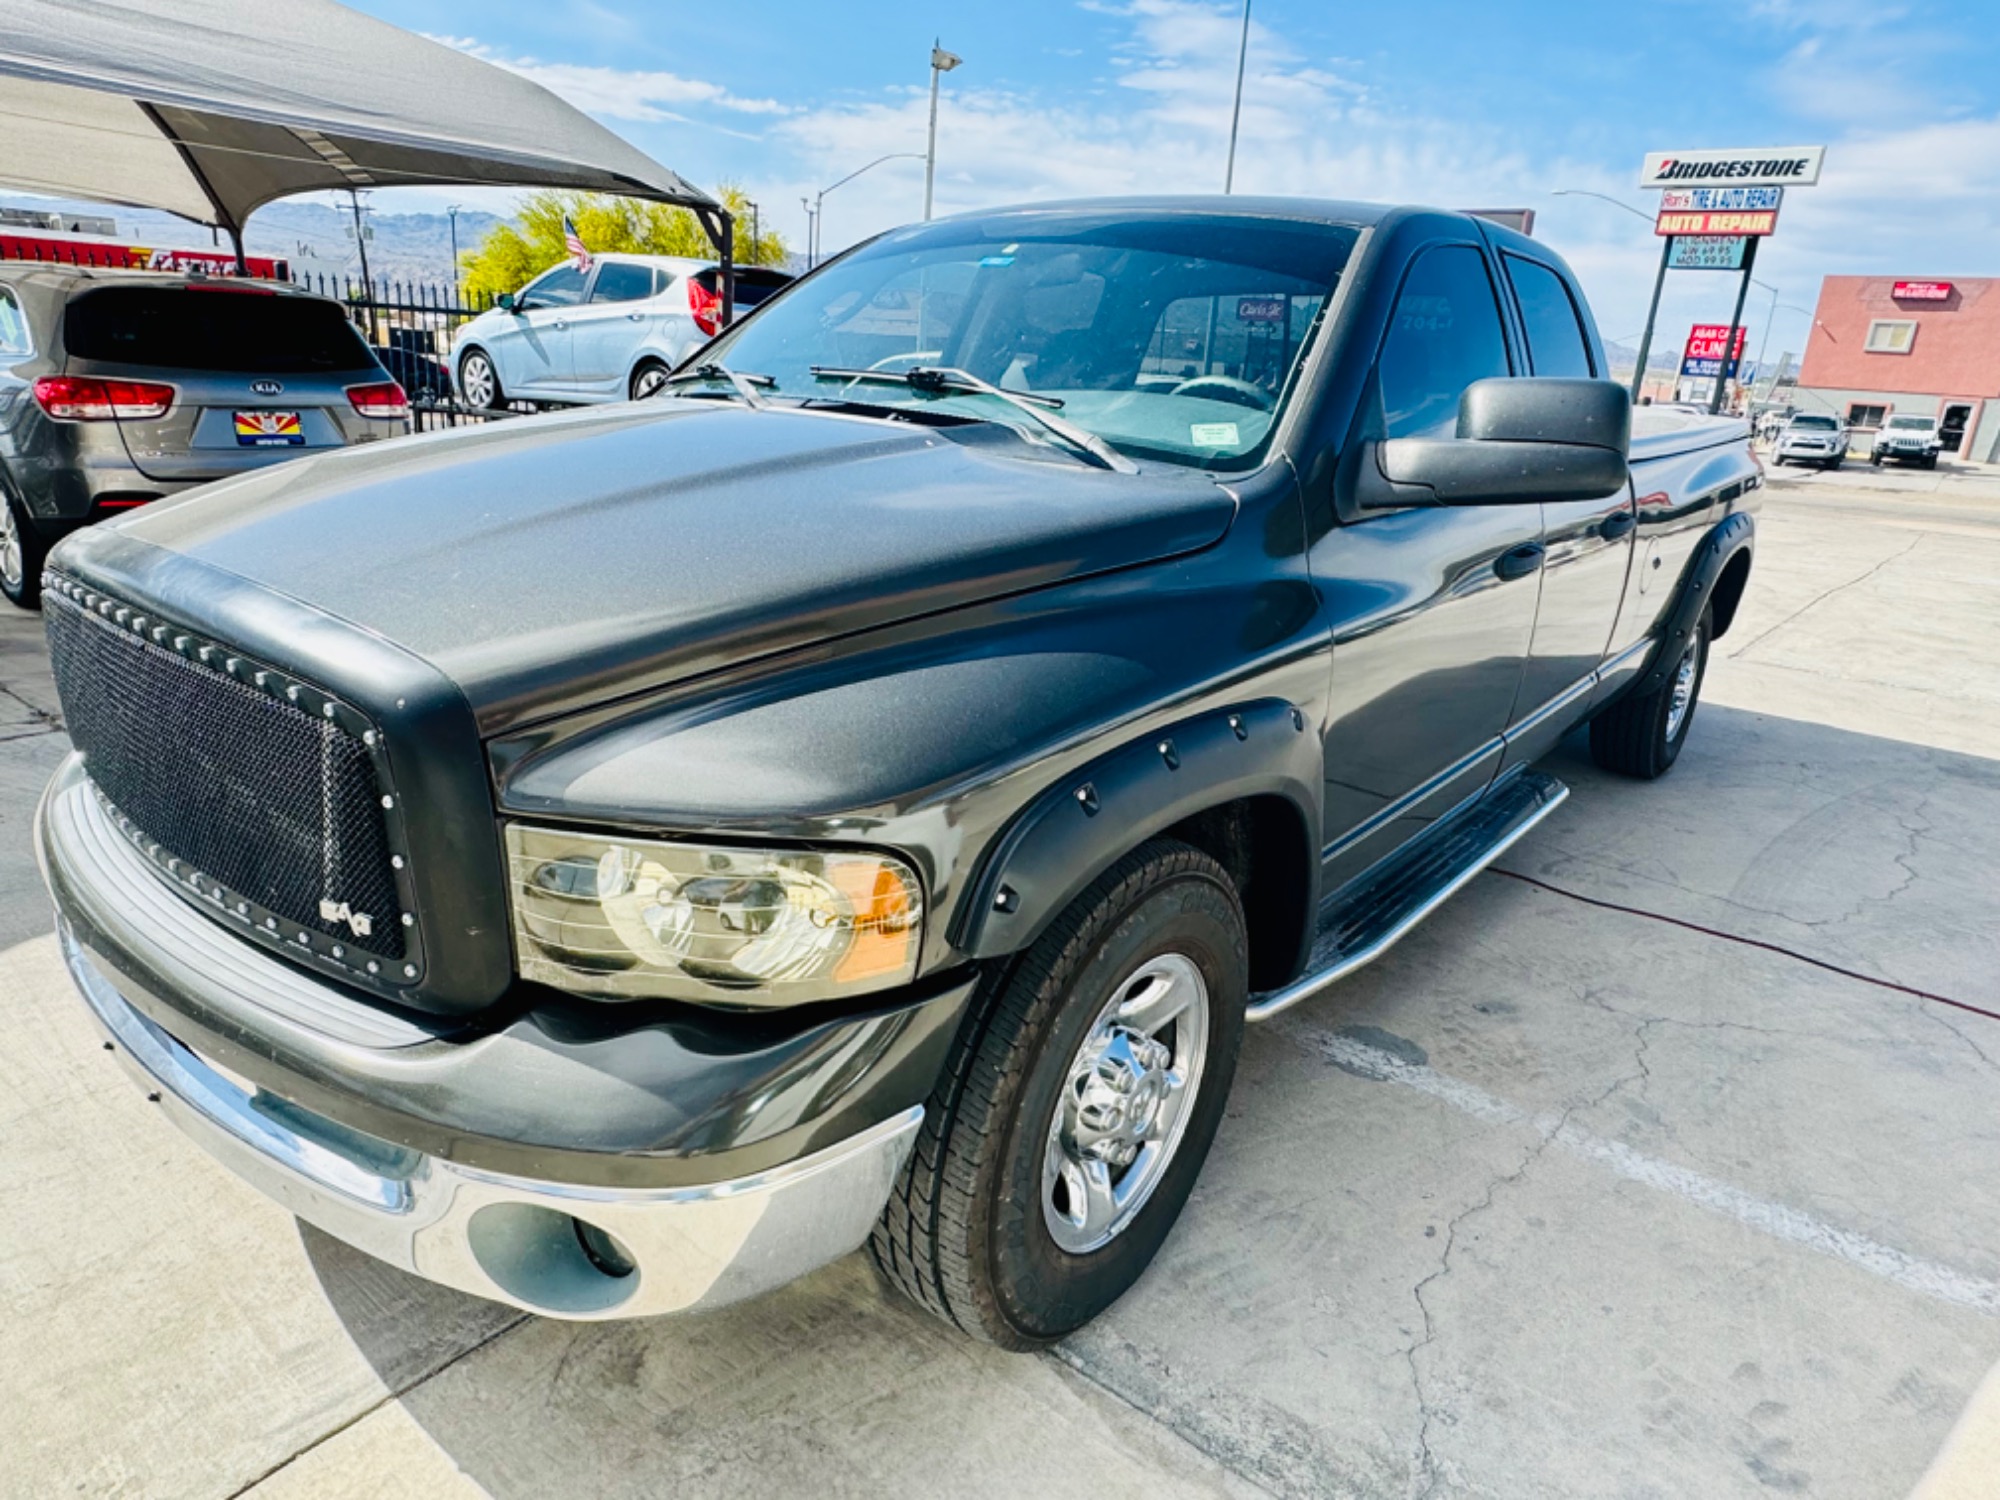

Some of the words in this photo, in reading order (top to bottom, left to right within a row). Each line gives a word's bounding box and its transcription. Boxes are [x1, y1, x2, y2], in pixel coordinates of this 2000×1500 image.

[1655, 157, 1810, 180] BRIDGESTONE
[1692, 189, 1710, 208] TIRE
[1720, 189, 1744, 208] AUTO
[1745, 188, 1777, 208] REPAIR
[1658, 214, 1703, 232] AUTO
[1707, 214, 1772, 232] REPAIR
